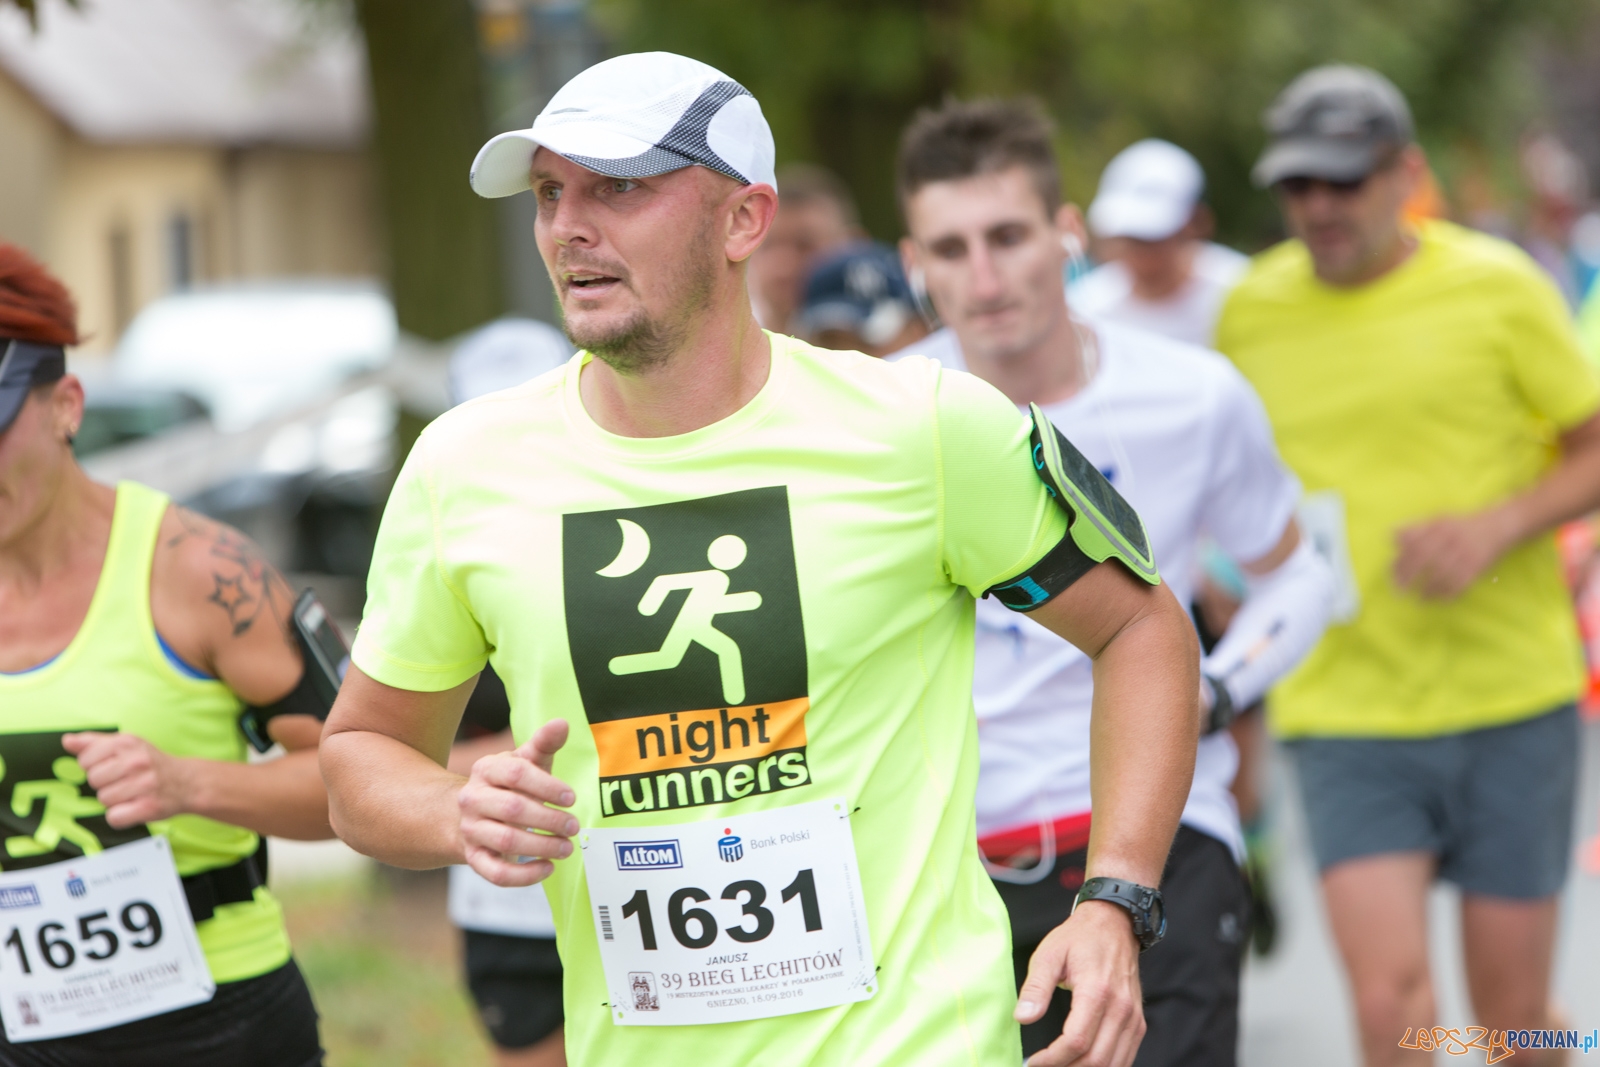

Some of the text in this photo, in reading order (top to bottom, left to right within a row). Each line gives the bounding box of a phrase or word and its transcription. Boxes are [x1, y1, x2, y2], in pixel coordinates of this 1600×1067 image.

[636, 707, 770, 764] night
[600, 751, 809, 816] runners
[750, 829, 810, 850] Bank Polski
[621, 868, 823, 951] 1631
[6, 901, 163, 975] 1659
[706, 952, 749, 966] JANUSZ
[660, 948, 844, 990] 39 BIEG LECHITÓW
[752, 989, 804, 1004] 18.09.2016
